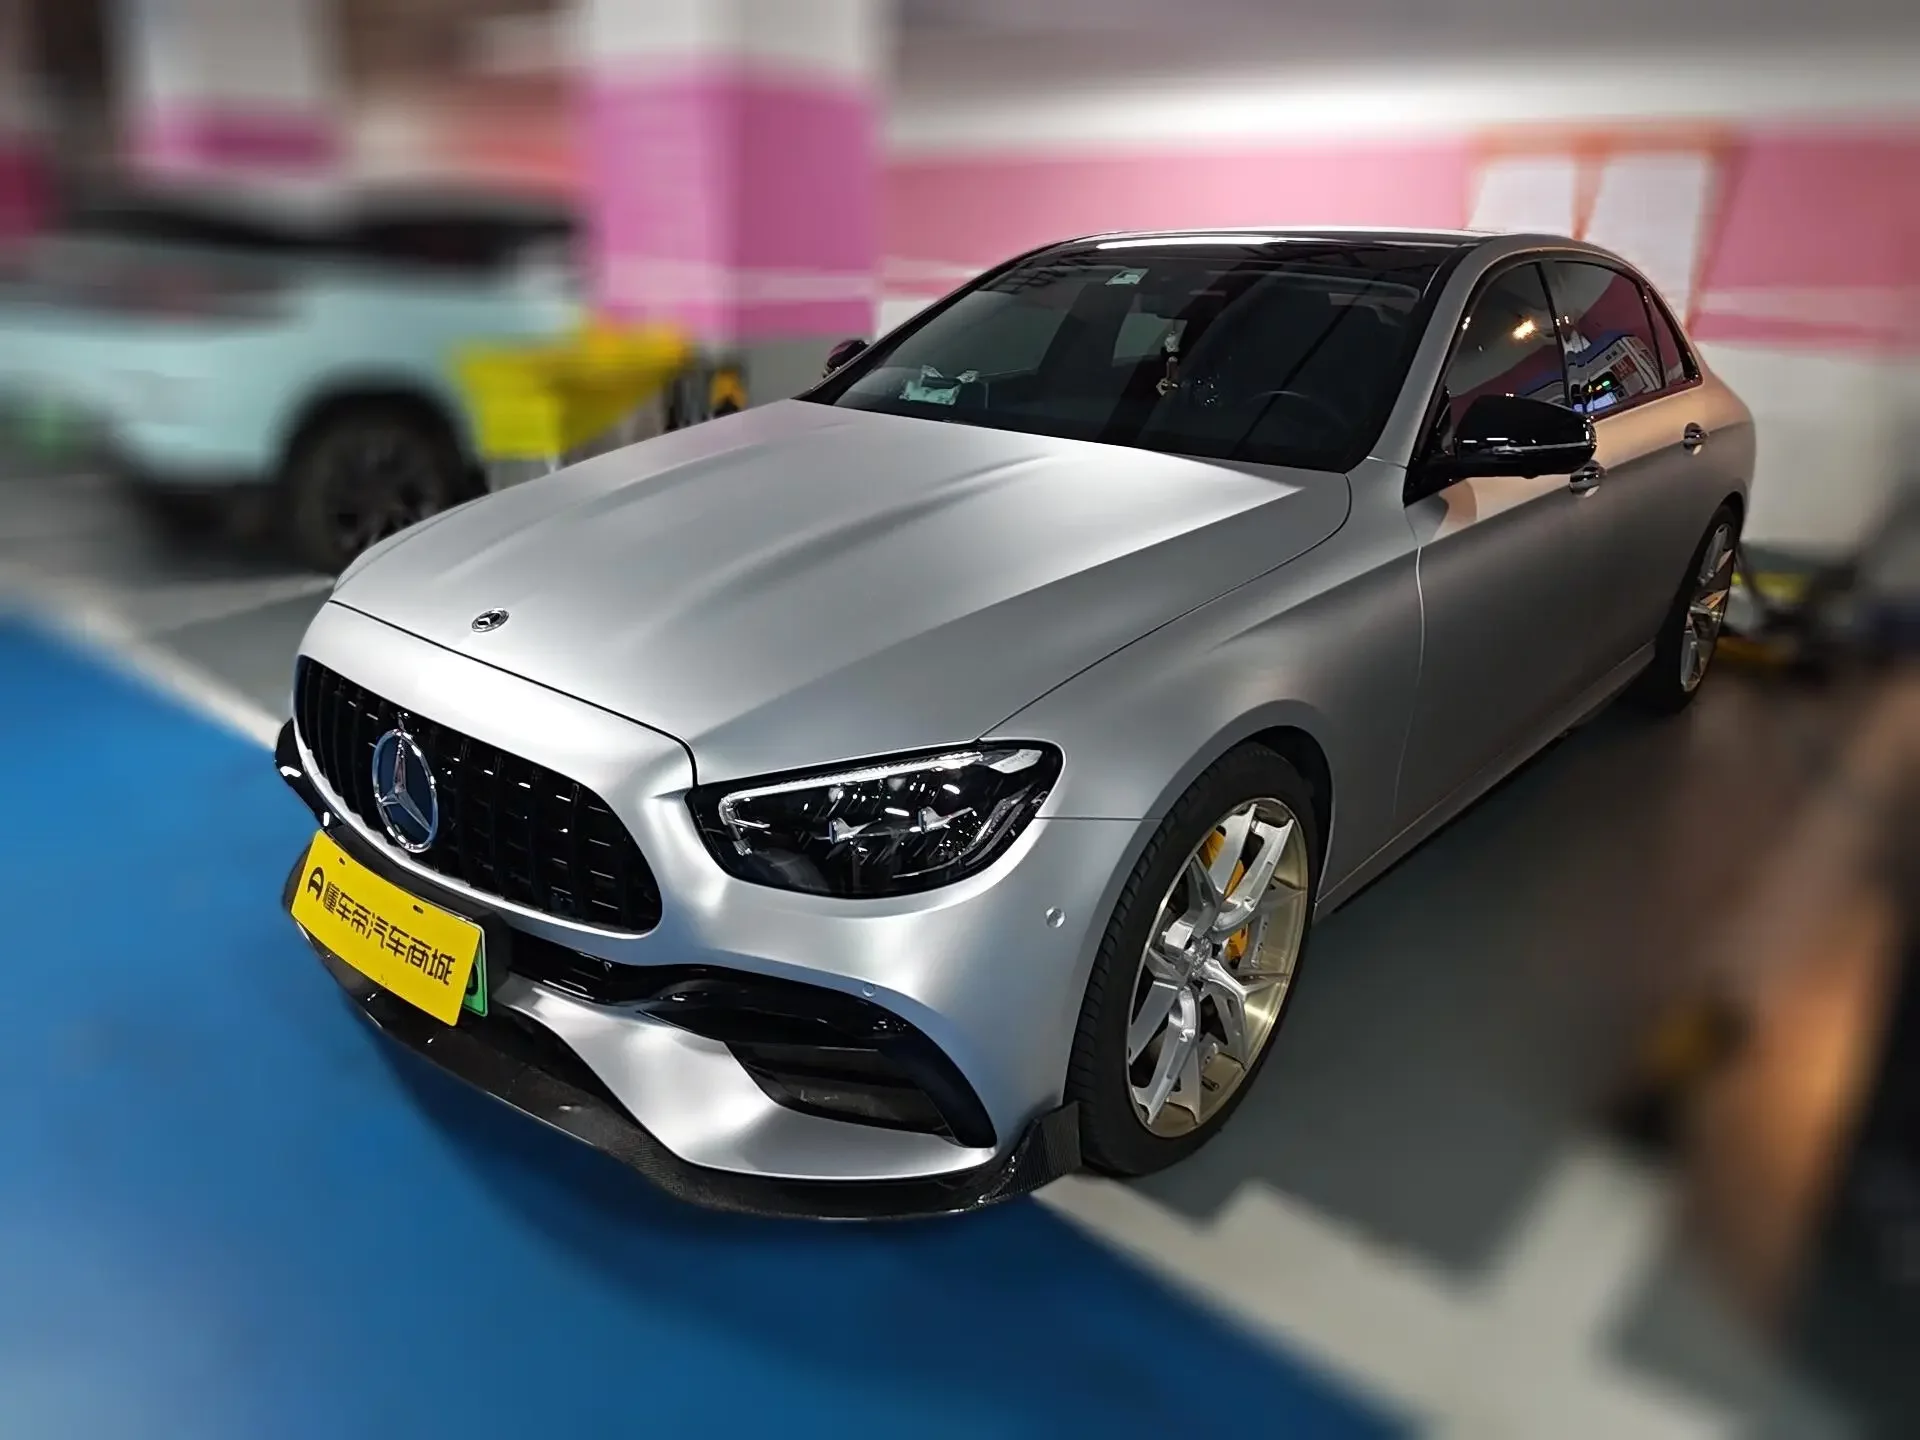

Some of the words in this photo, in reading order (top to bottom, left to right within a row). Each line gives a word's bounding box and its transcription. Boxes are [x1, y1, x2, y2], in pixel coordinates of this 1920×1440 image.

[323, 881, 456, 986] 懂车帝汽车商城
